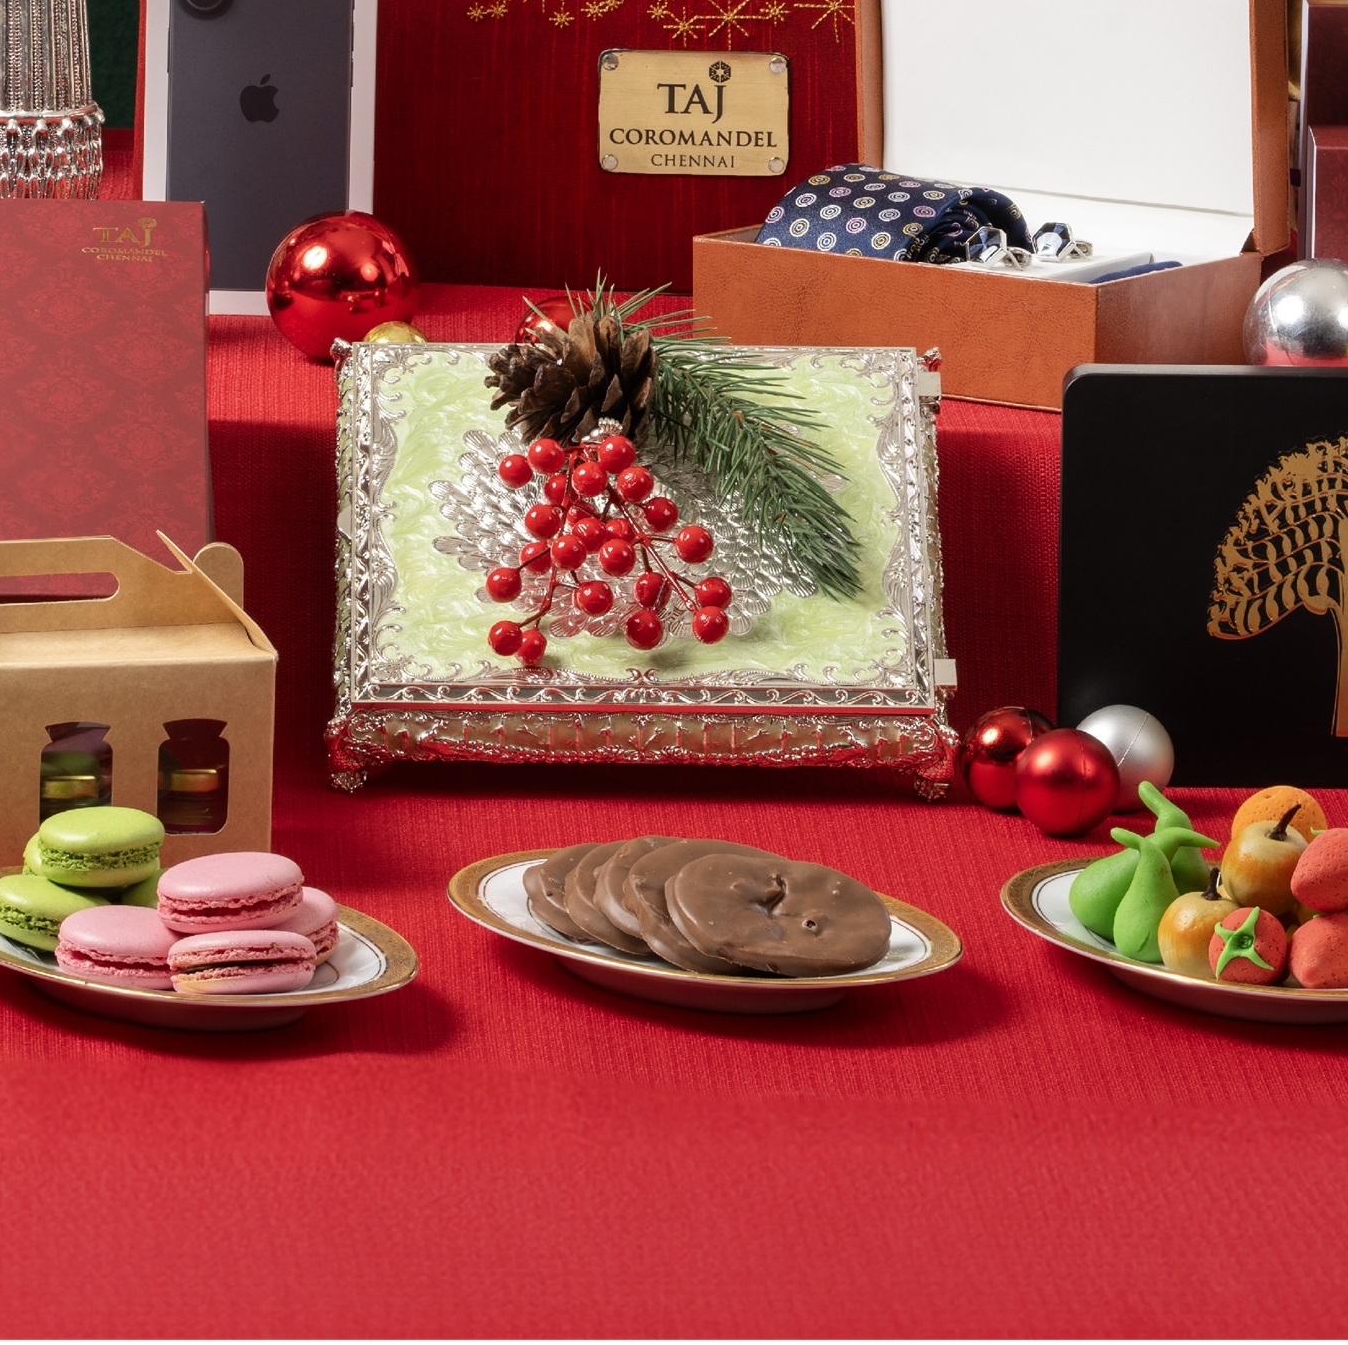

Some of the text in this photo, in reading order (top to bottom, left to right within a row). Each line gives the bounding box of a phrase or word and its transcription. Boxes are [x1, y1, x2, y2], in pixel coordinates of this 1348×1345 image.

[657, 83, 727, 124] TAJ
[609, 128, 778, 148] COROMANDEL
[651, 154, 735, 168] CHENNAI
[93, 227, 154, 248] TAJ
[81, 247, 168, 256] COROMANDEL
[96, 254, 153, 262] CHENNAI
